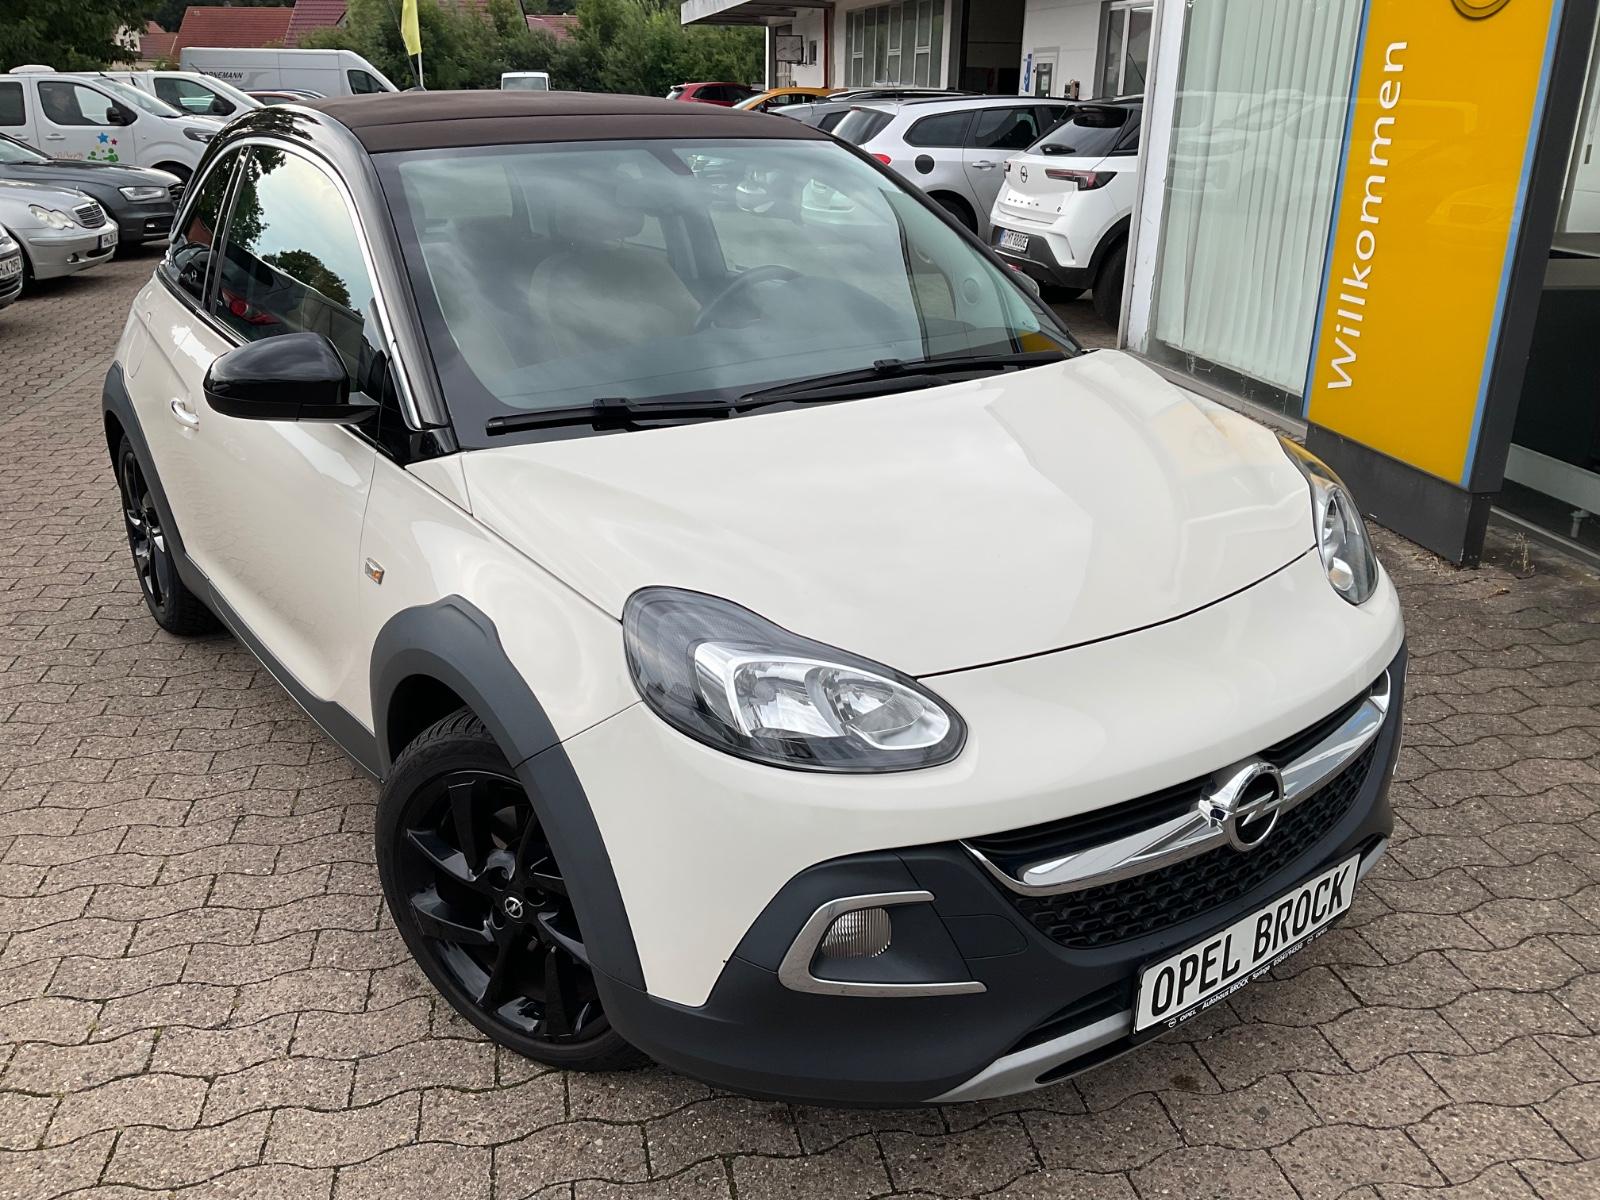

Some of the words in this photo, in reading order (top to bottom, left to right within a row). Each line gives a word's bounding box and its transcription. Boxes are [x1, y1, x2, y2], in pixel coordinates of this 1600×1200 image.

[1327, 41, 1407, 389] Willkommen
[1151, 934, 1240, 1017] OPEL
[1252, 865, 1350, 963] BROCK
[1230, 977, 1249, 994] BROCK
